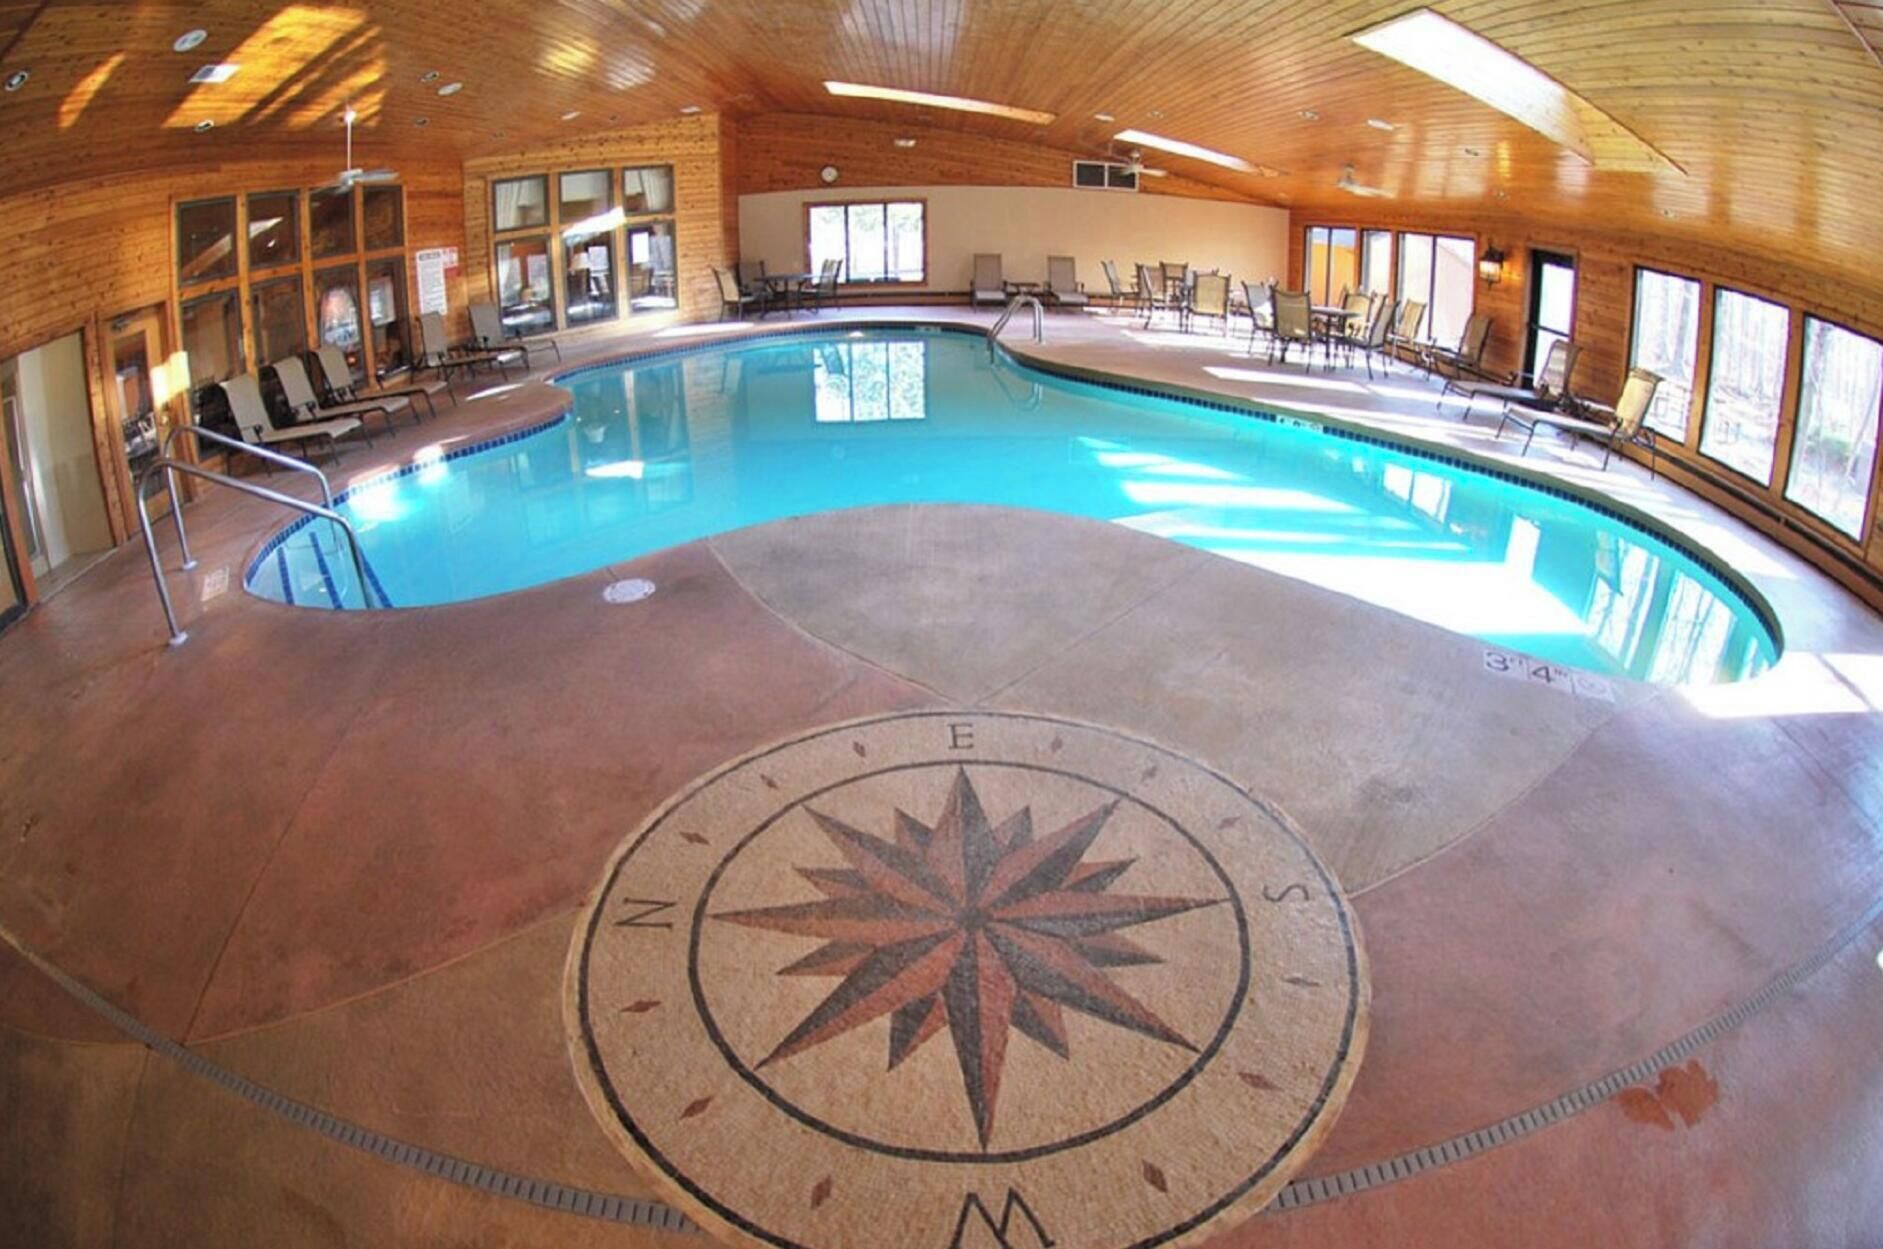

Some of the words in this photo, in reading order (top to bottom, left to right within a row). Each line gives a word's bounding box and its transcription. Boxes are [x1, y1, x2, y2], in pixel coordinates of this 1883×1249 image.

[946, 722, 974, 750] E
[1261, 883, 1310, 903] S
[614, 897, 677, 930] N
